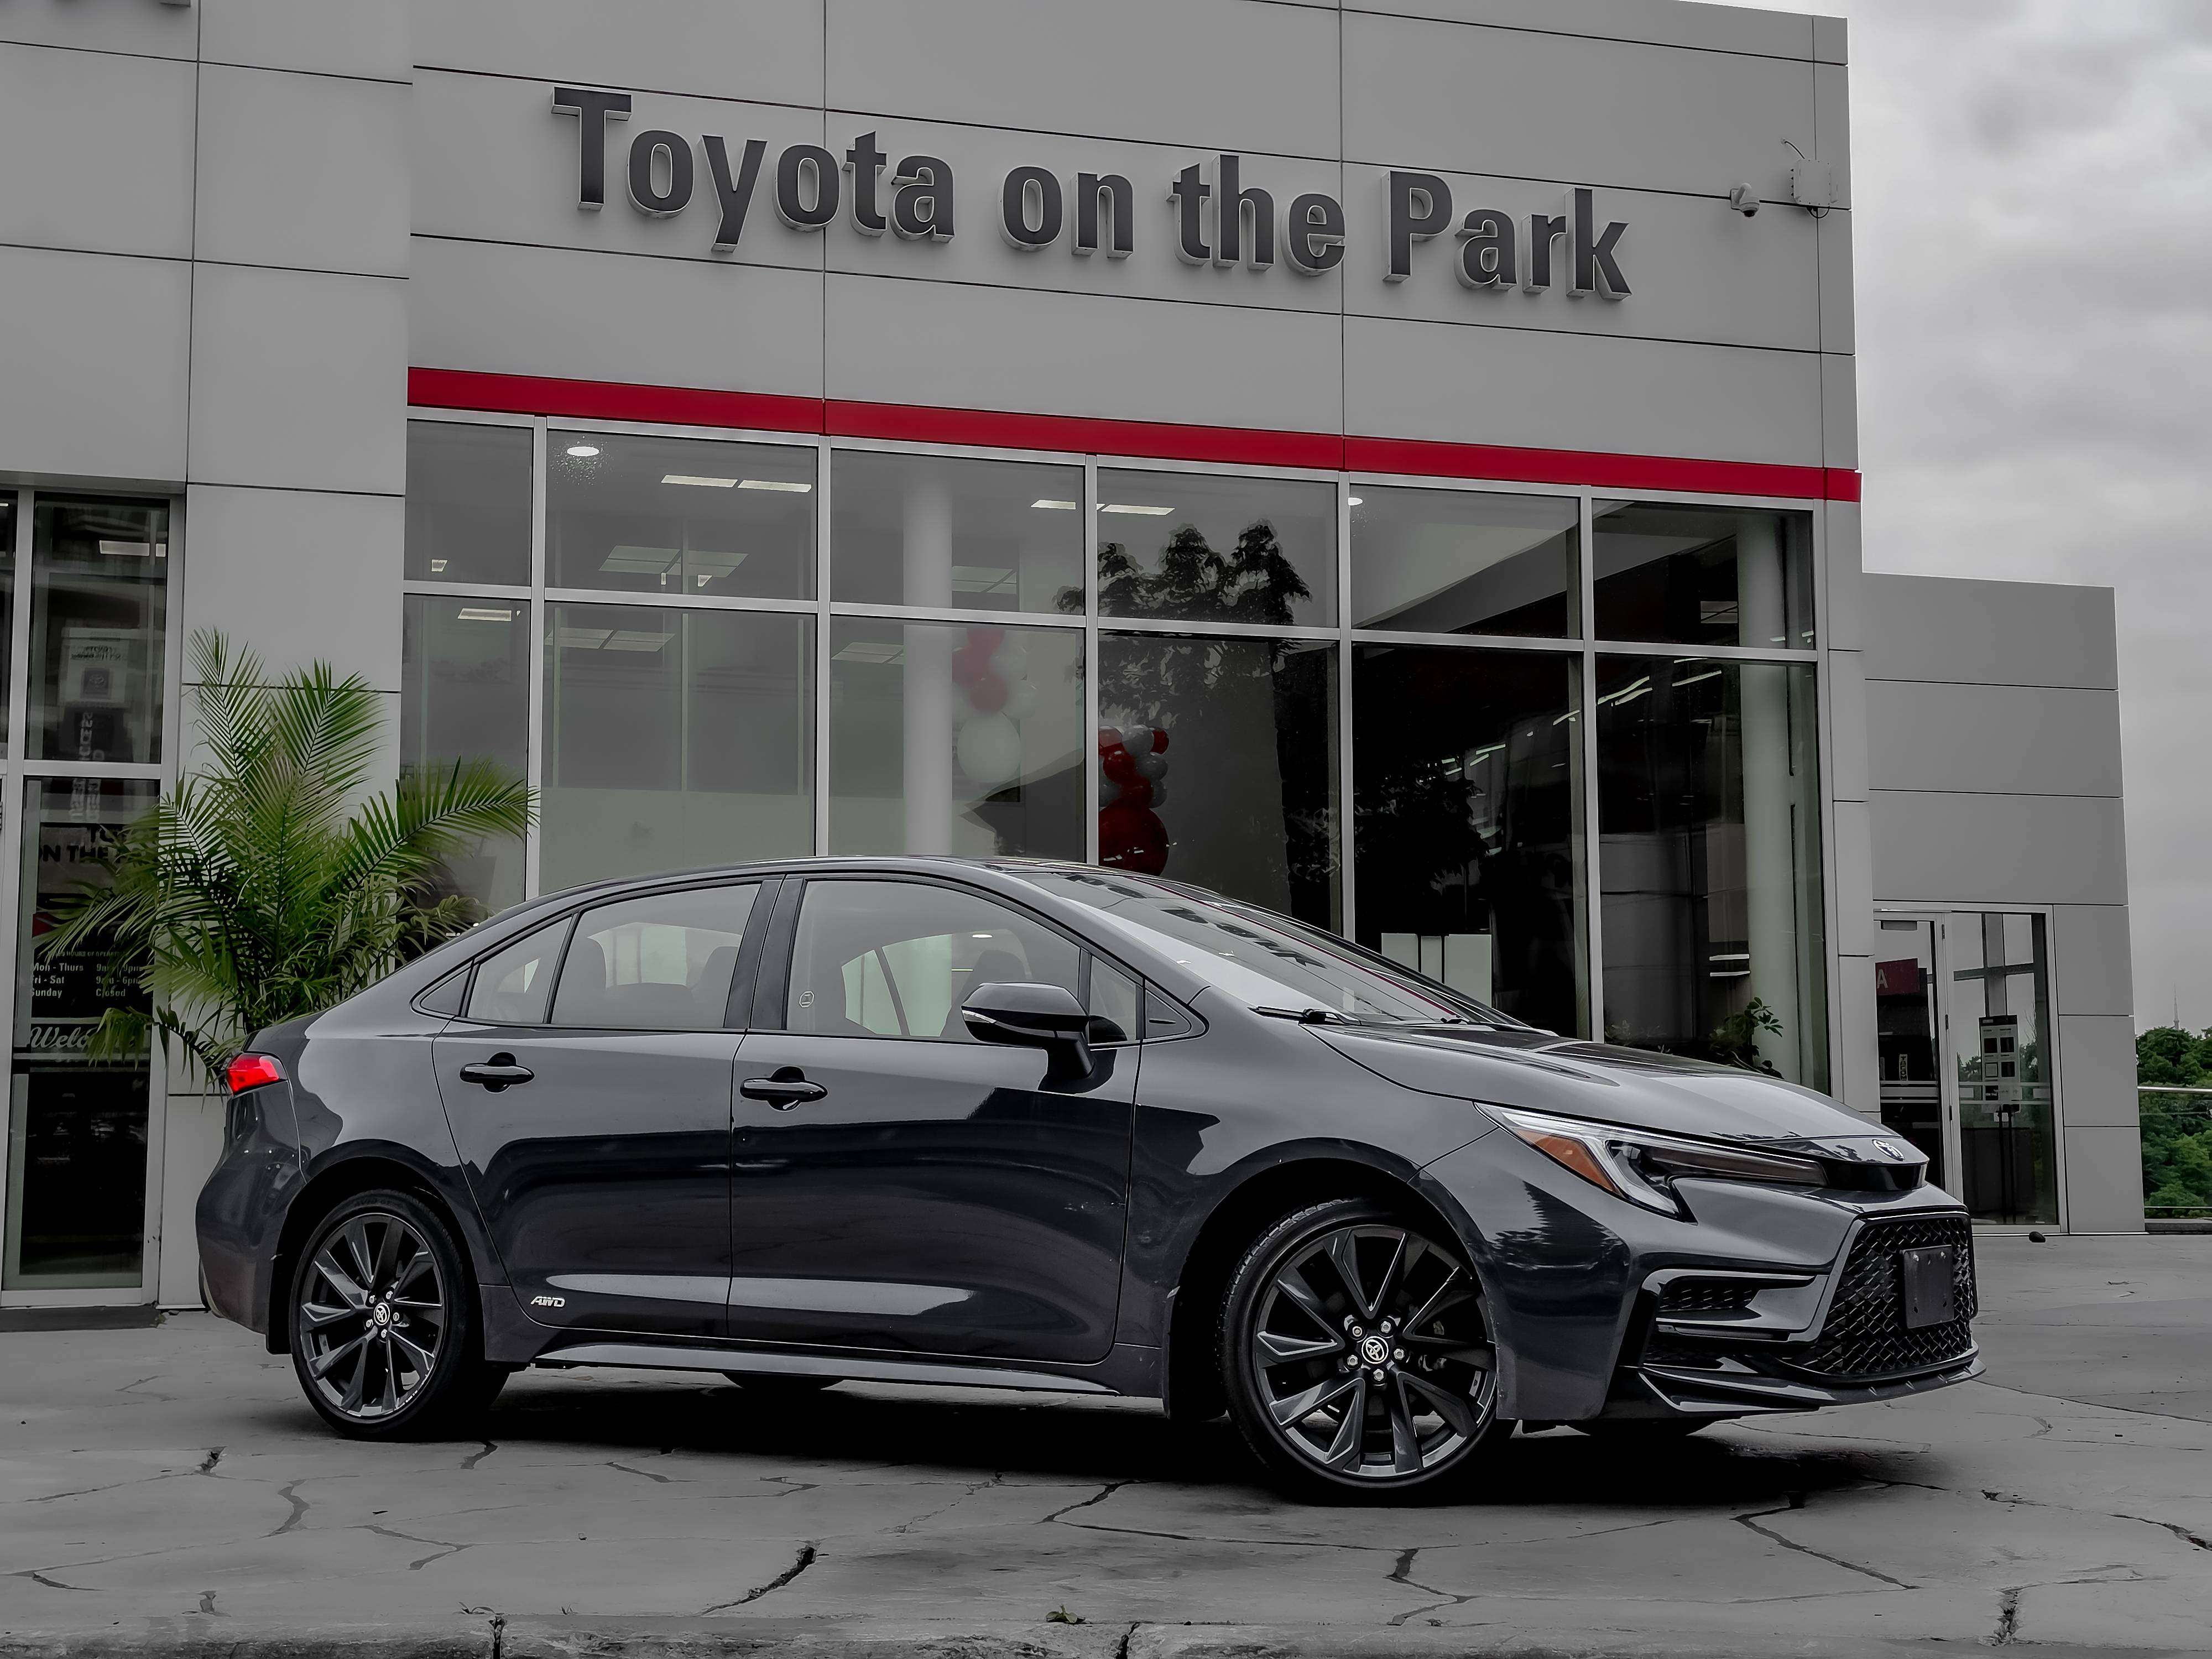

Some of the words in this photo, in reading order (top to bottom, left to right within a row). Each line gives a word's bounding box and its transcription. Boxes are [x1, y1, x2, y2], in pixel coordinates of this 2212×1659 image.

[551, 86, 955, 253] Toyota
[999, 166, 1134, 259] on
[1166, 154, 1346, 276] the
[1381, 170, 1632, 301] Park
[39, 845, 60, 862] N
[530, 1296, 566, 1308] AWD
